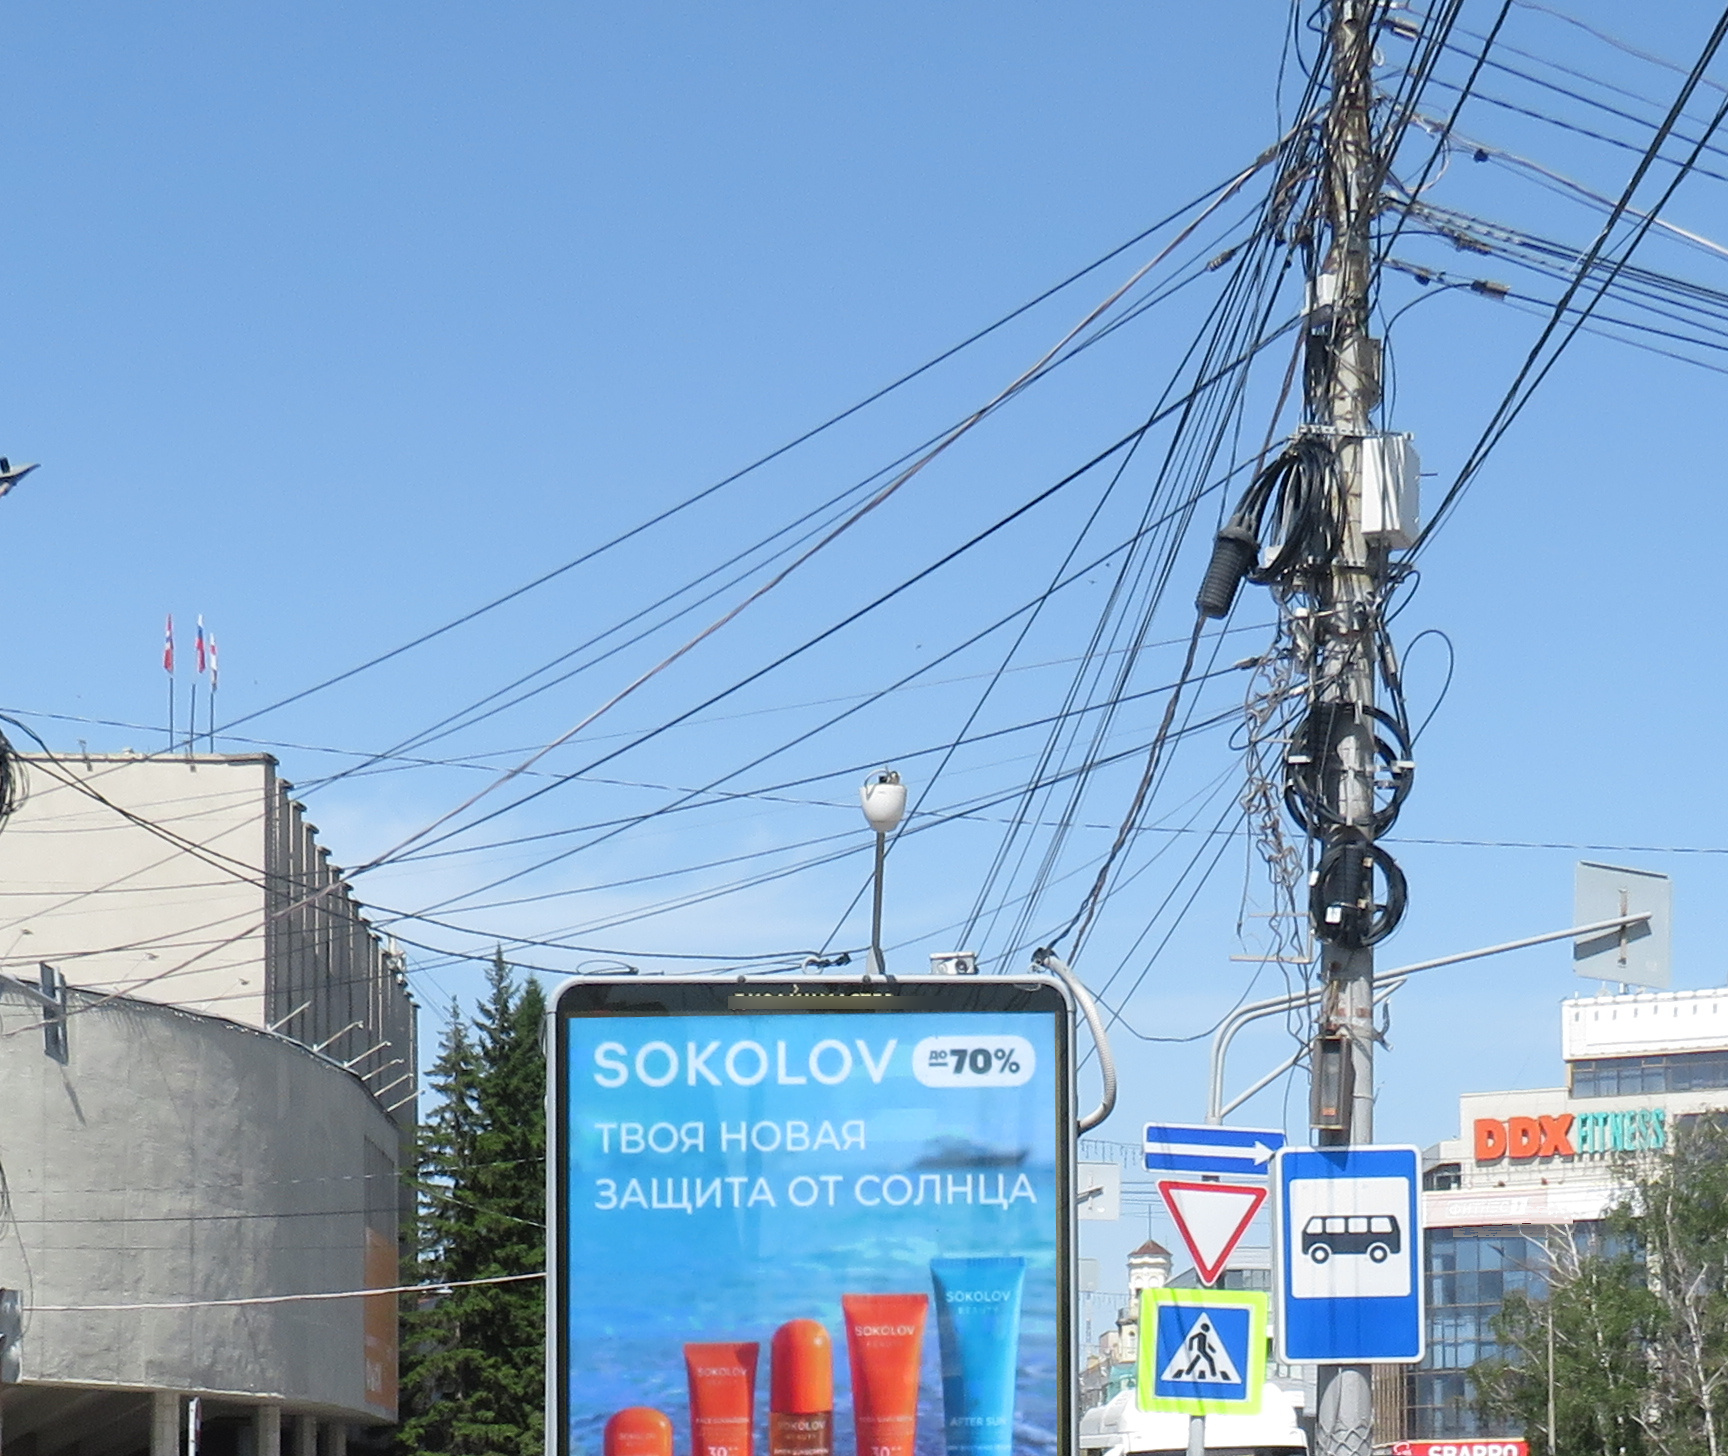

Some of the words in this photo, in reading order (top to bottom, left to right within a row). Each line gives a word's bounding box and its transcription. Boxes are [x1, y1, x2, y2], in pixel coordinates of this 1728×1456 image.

[593, 1038, 898, 1088] SOKOLOV
[594, 1121, 705, 1154] ТВОЯ
[720, 1120, 866, 1152] НОВАЯ
[1474, 1114, 1575, 1162] DDX
[1576, 1107, 1666, 1154] FITNESS
[594, 1177, 776, 1214] ЗАЩИТА
[788, 1175, 843, 1208] ОТ
[854, 1173, 1038, 1210] СОЛНЦА
[946, 1290, 1012, 1303] SOKOLOV
[854, 1325, 915, 1337] SOKOLOV
